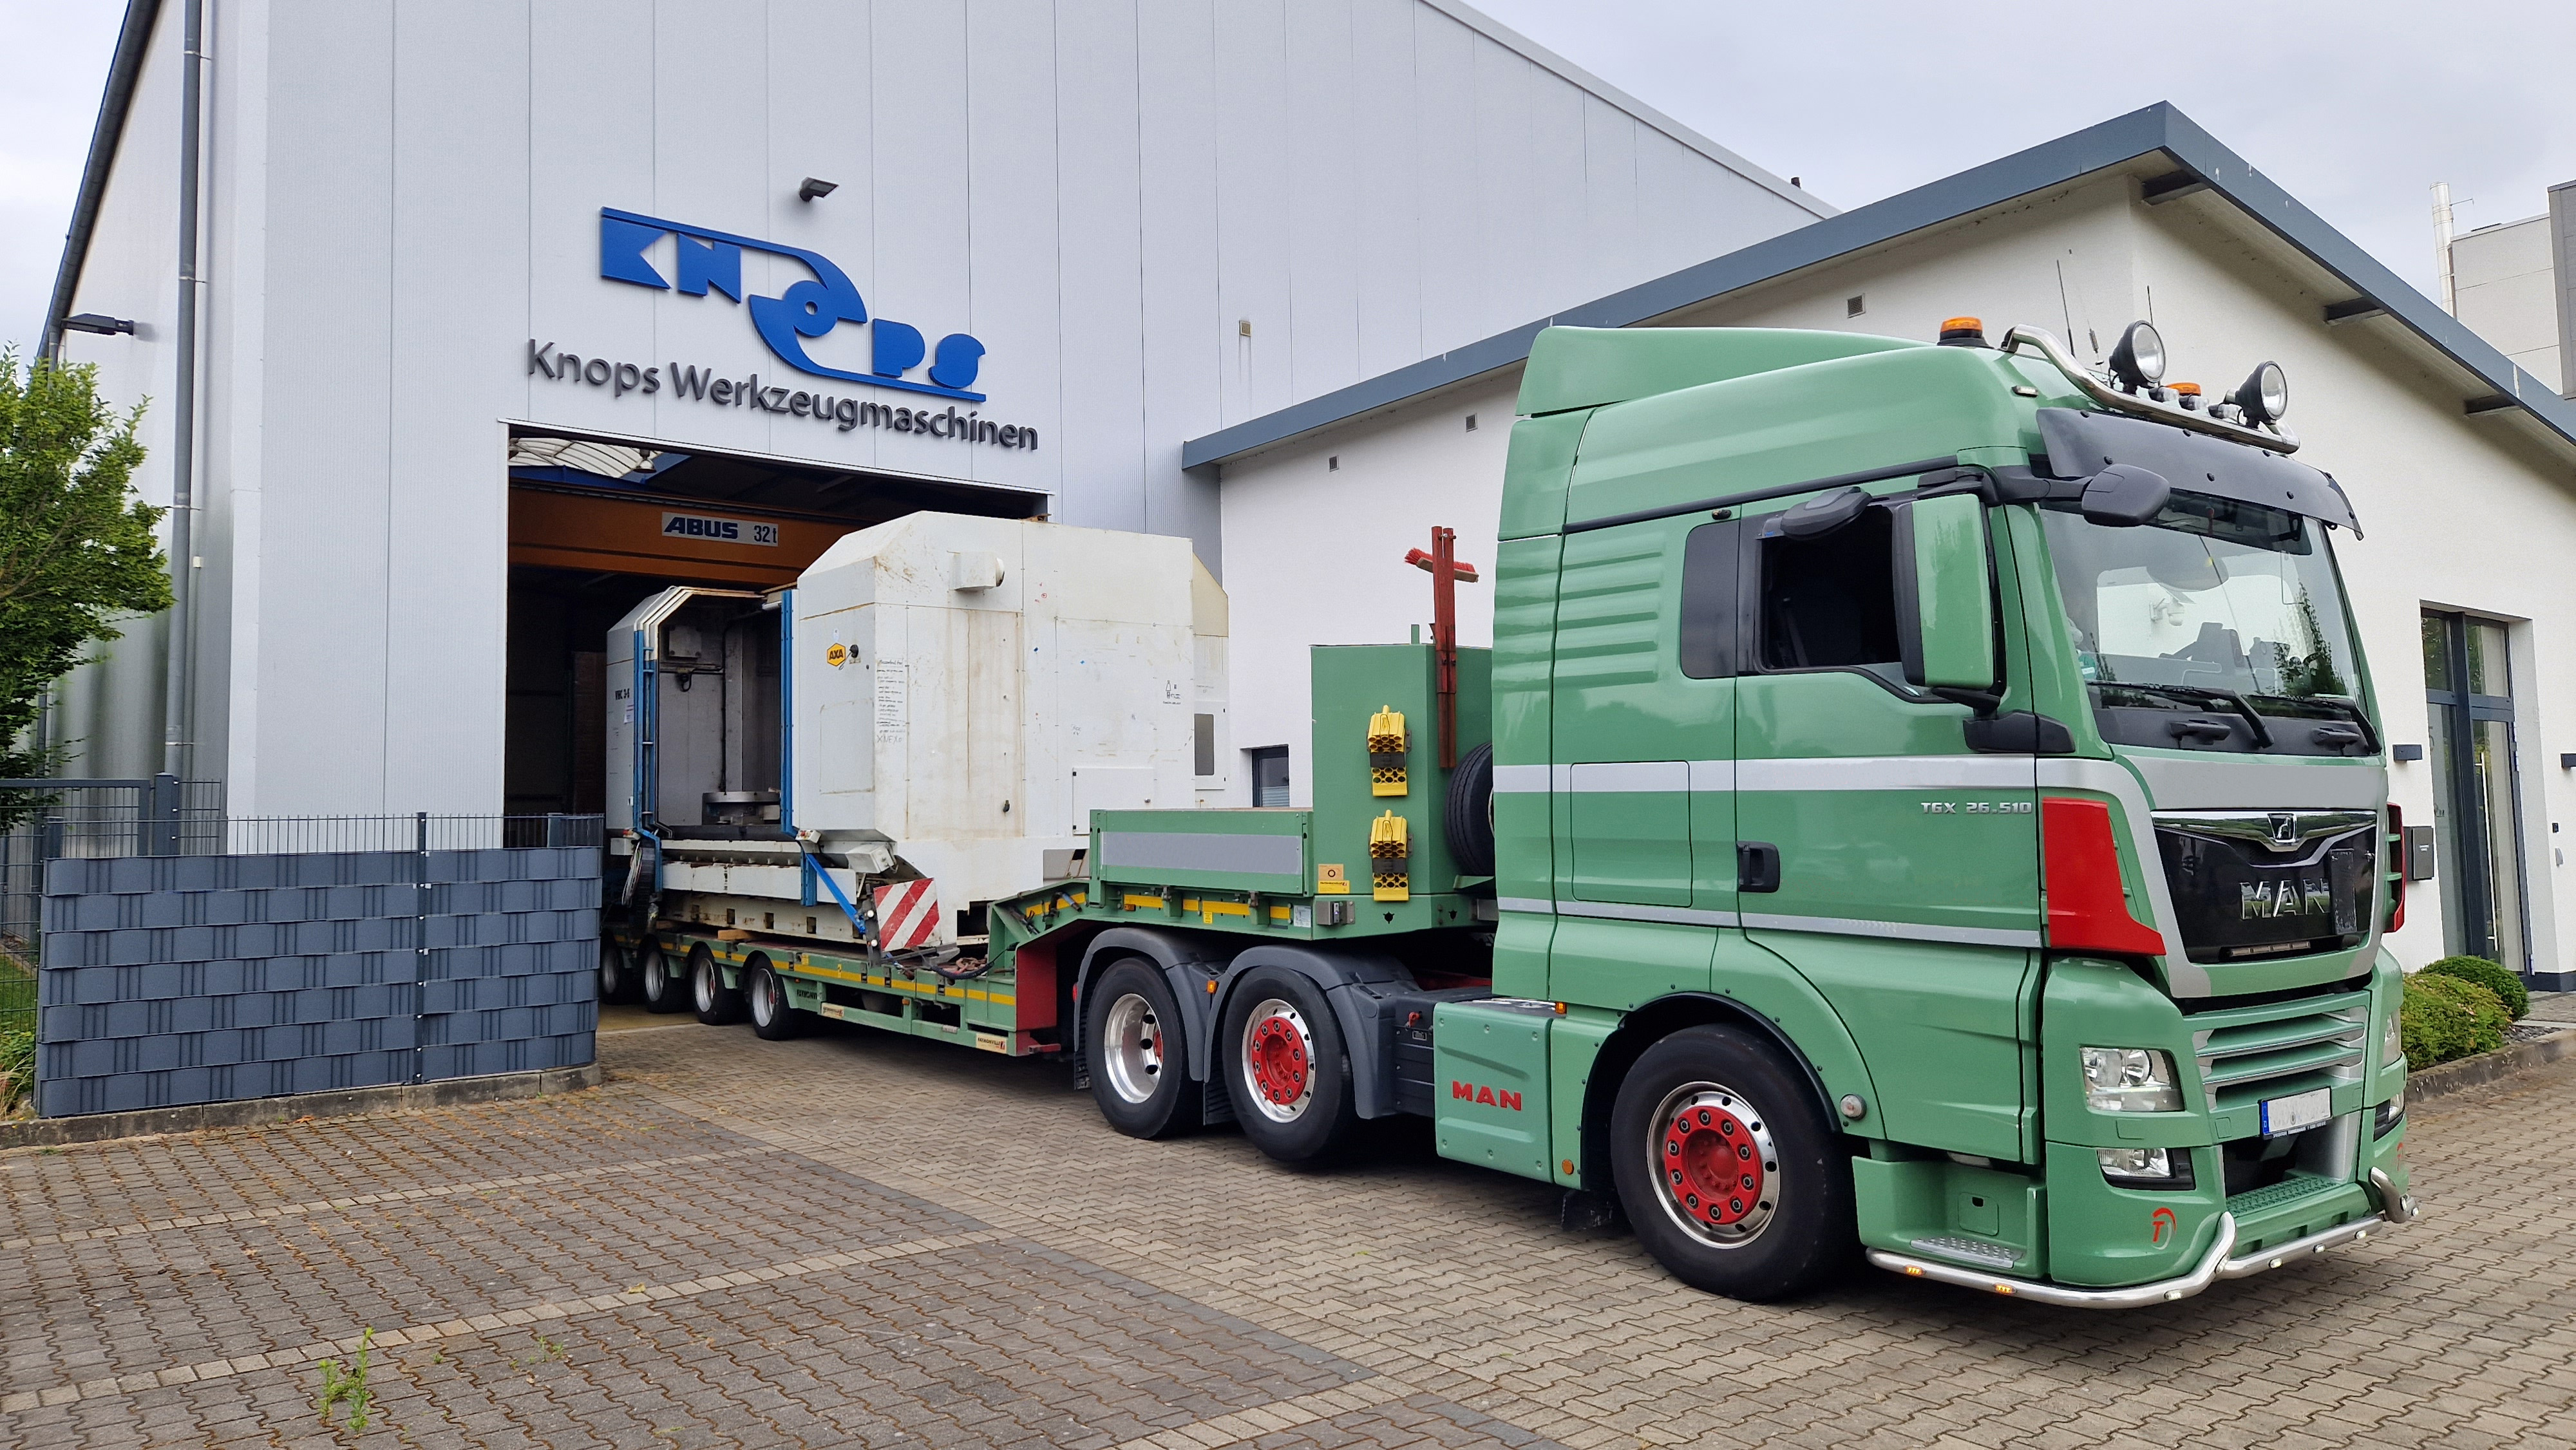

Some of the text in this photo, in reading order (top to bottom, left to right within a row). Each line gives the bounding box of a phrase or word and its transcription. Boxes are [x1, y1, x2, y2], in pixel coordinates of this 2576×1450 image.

[600, 206, 987, 403] KNOPS
[528, 338, 1039, 451] Knops Werkzeugmaschinen
[664, 516, 738, 540] ABUS
[828, 648, 844, 661] AXA
[1920, 802, 2032, 814] TGX 26.510
[2240, 878, 2330, 921] MAN
[1452, 1080, 1522, 1111] MAN
